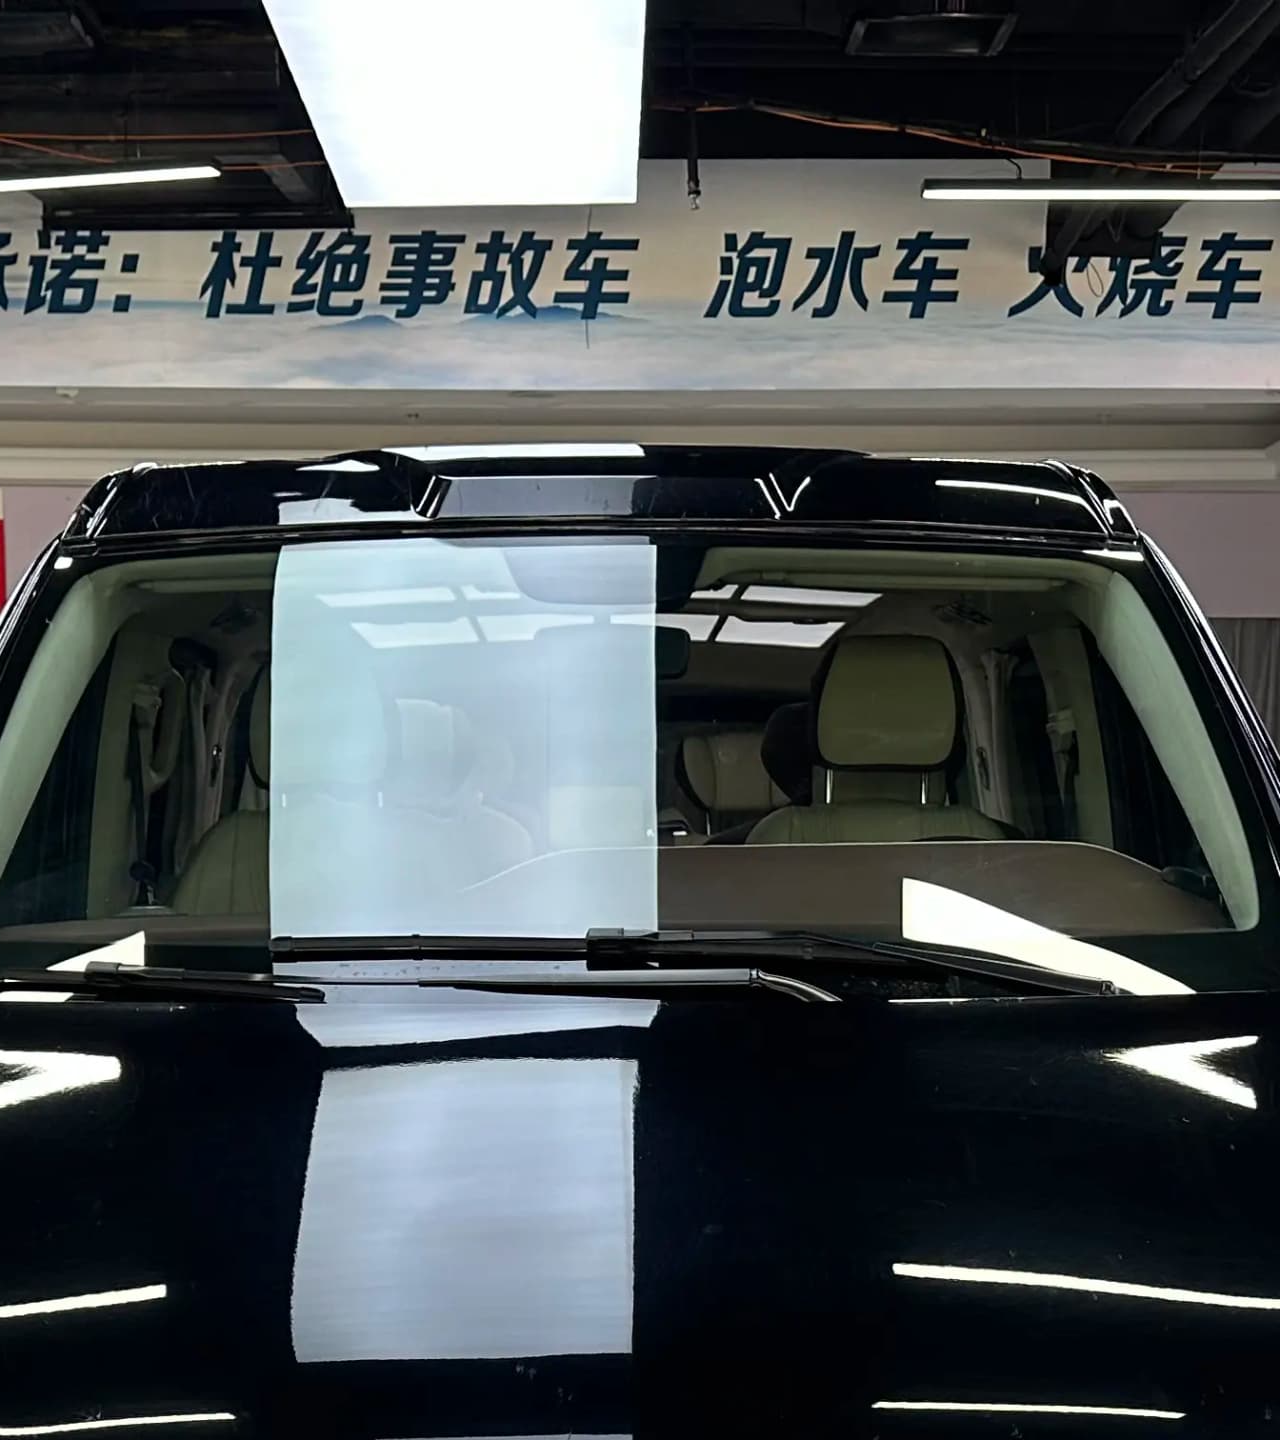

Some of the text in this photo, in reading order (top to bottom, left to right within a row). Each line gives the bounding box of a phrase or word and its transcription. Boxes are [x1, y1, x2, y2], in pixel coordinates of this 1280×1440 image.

[199, 231, 640, 320] 杜绝事故车
[703, 230, 970, 319] 泡水车
